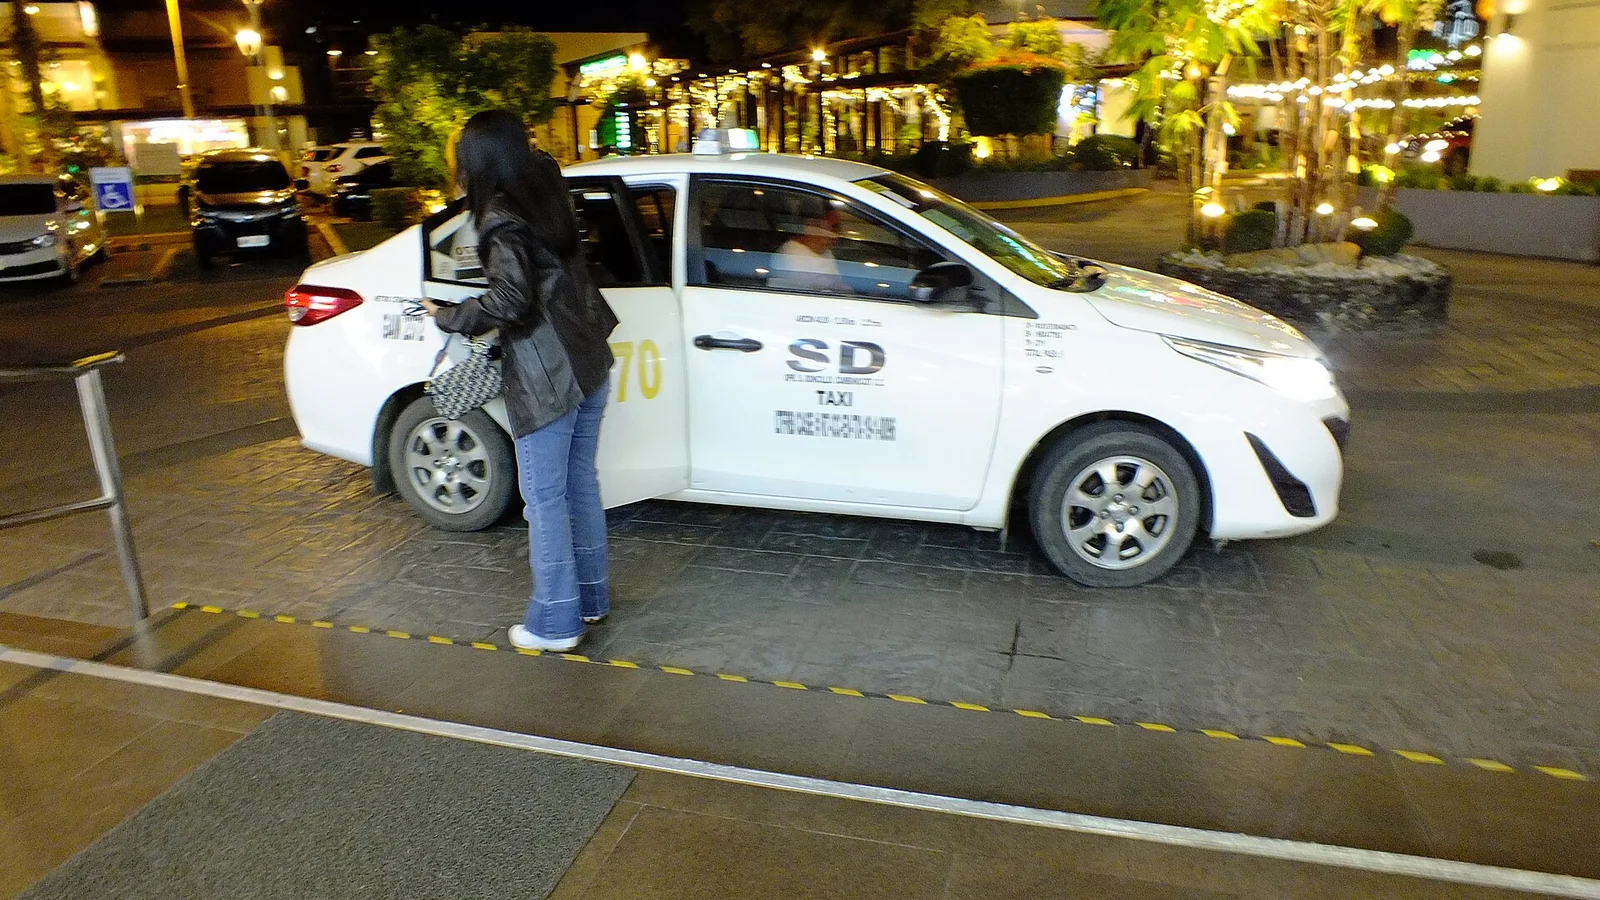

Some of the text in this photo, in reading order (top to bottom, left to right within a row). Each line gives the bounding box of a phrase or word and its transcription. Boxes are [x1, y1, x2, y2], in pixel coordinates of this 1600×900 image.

[609, 339, 662, 402] 70
[785, 338, 886, 374] SD
[815, 389, 853, 407] TAXI
